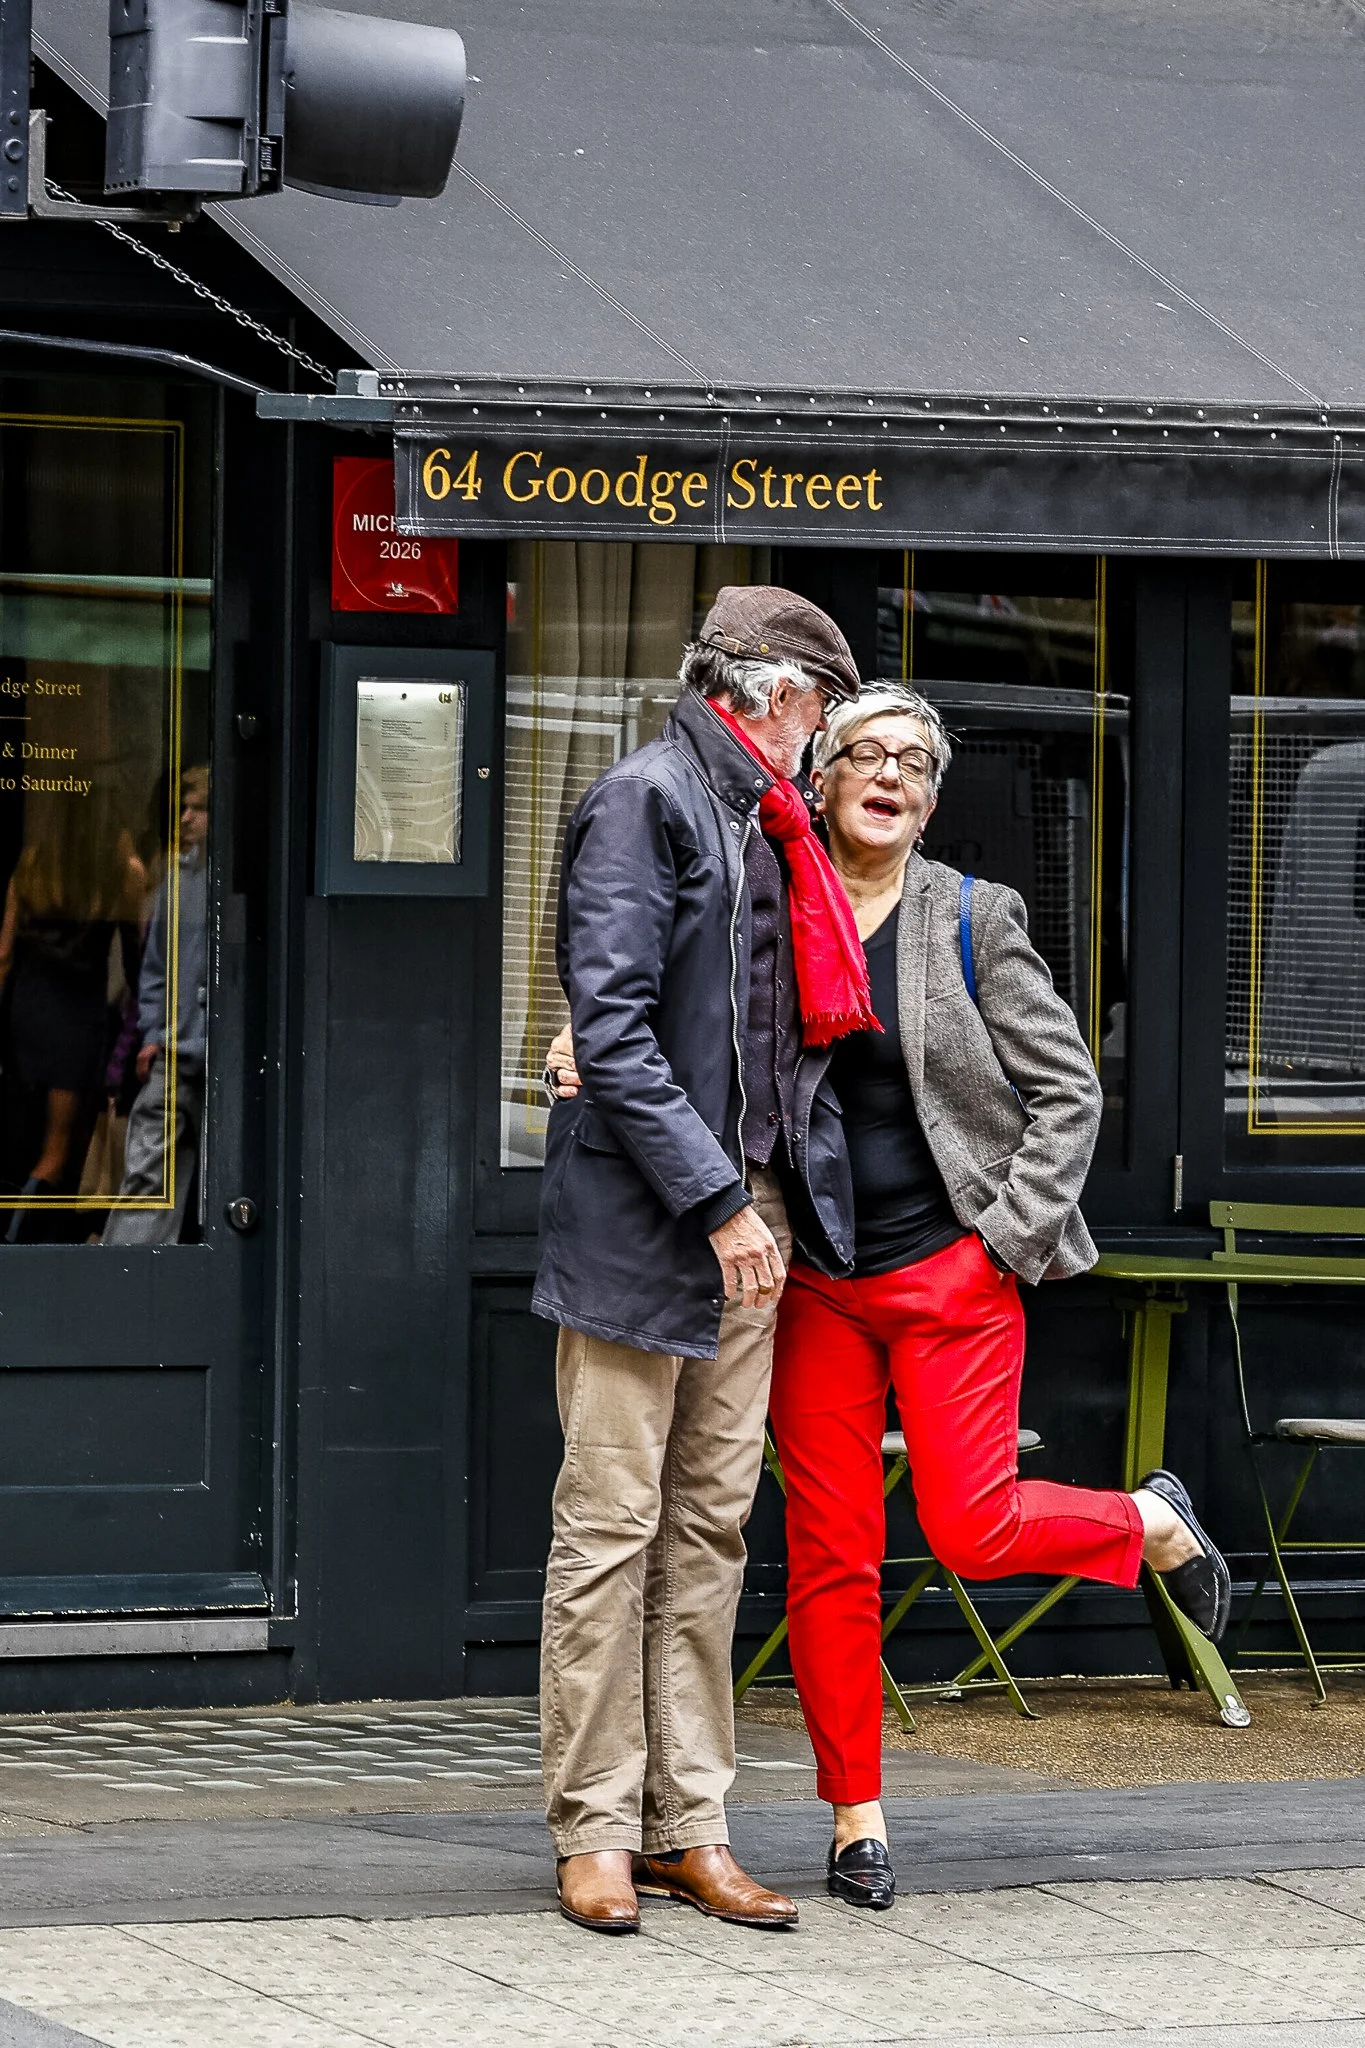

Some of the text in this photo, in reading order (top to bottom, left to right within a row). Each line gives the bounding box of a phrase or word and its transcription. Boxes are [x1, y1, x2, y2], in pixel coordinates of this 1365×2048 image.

[422, 447, 884, 525] 64 Goodge Street
[379, 541, 421, 560] 2026
[34, 678, 82, 696] Street
[2, 742, 78, 760] & Dinner
[0, 775, 92, 797] to Saturday
